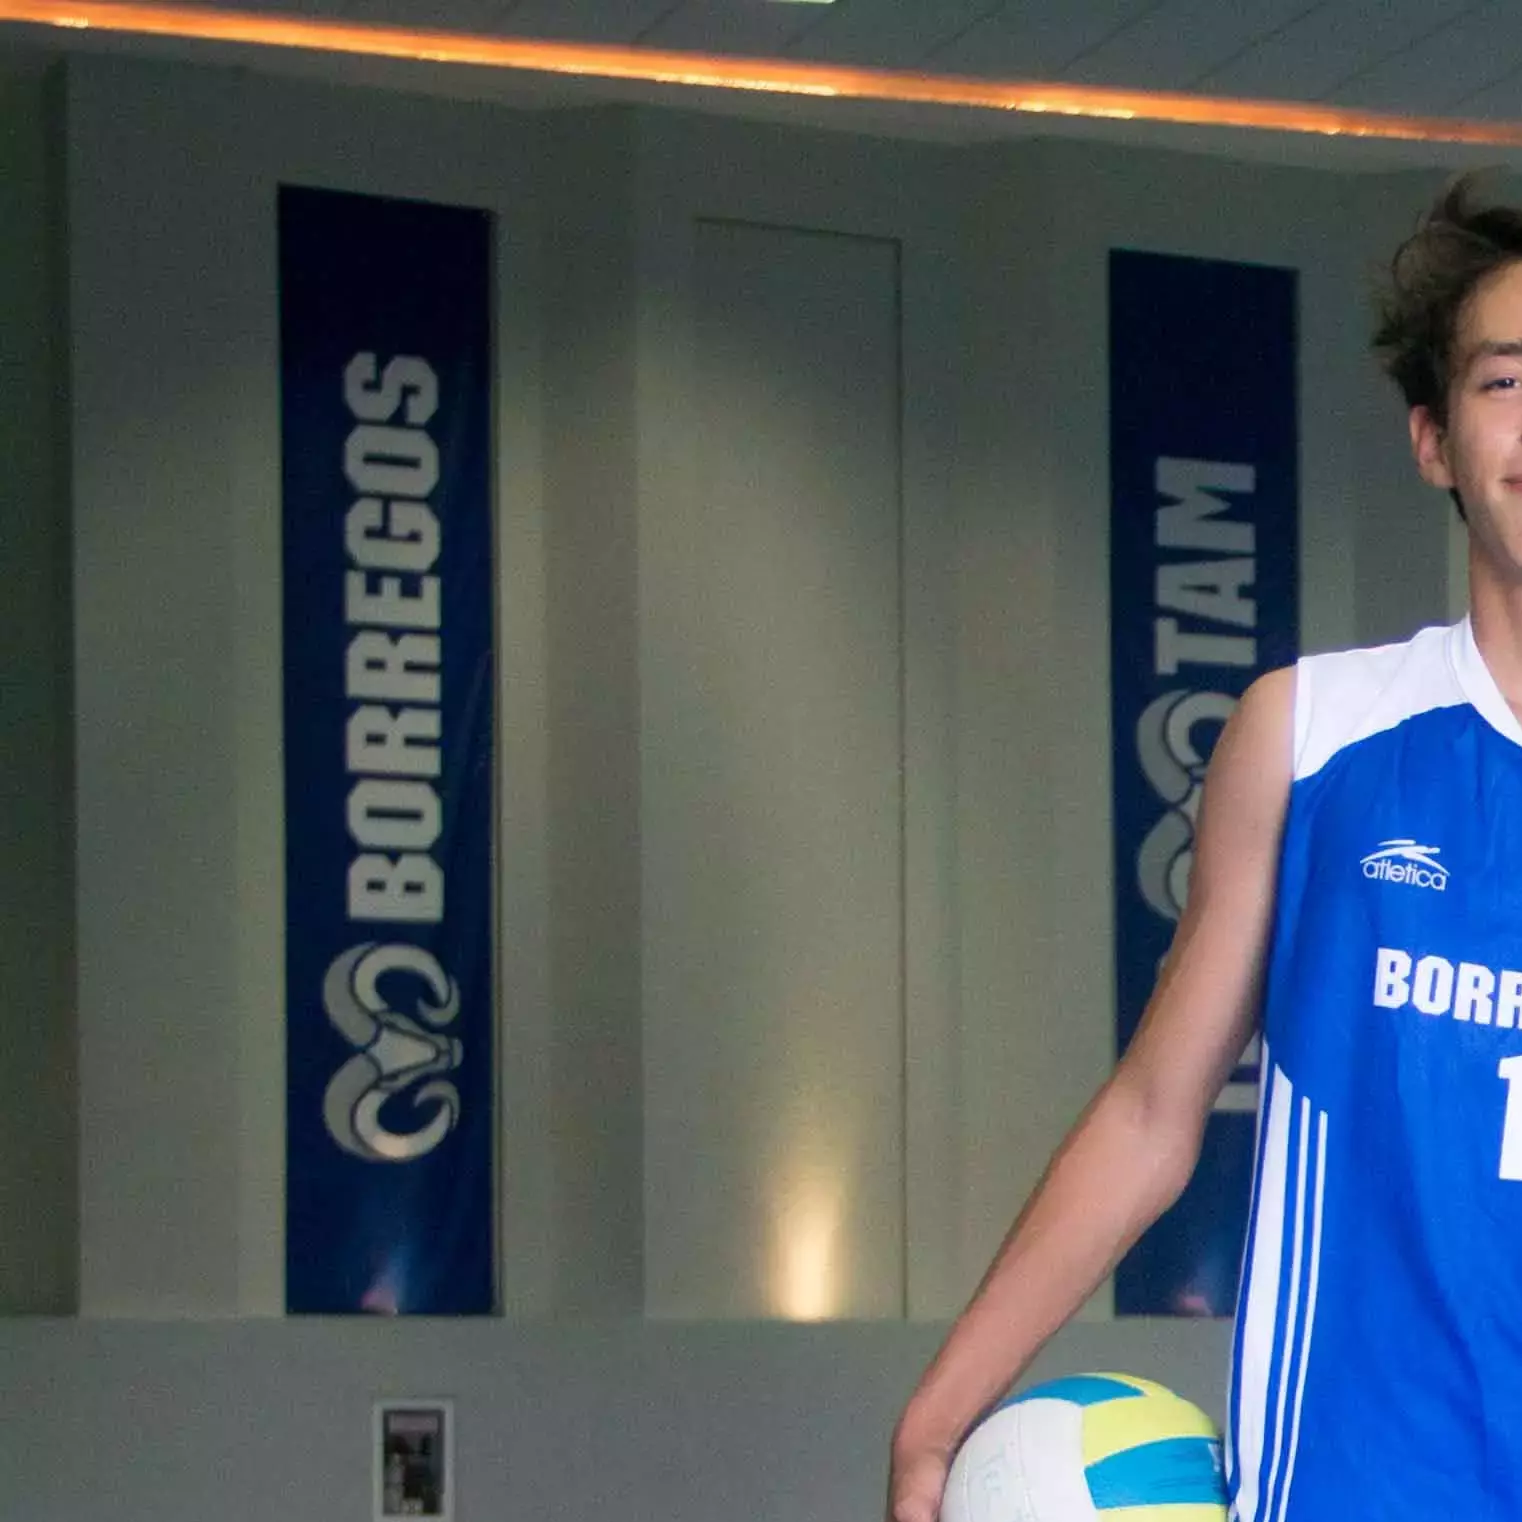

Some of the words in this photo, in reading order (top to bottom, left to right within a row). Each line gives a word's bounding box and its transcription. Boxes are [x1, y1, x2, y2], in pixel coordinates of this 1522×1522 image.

[344, 351, 445, 923] BORREGOS
[1155, 455, 1256, 676] TAM
[1363, 858, 1447, 891] atletica
